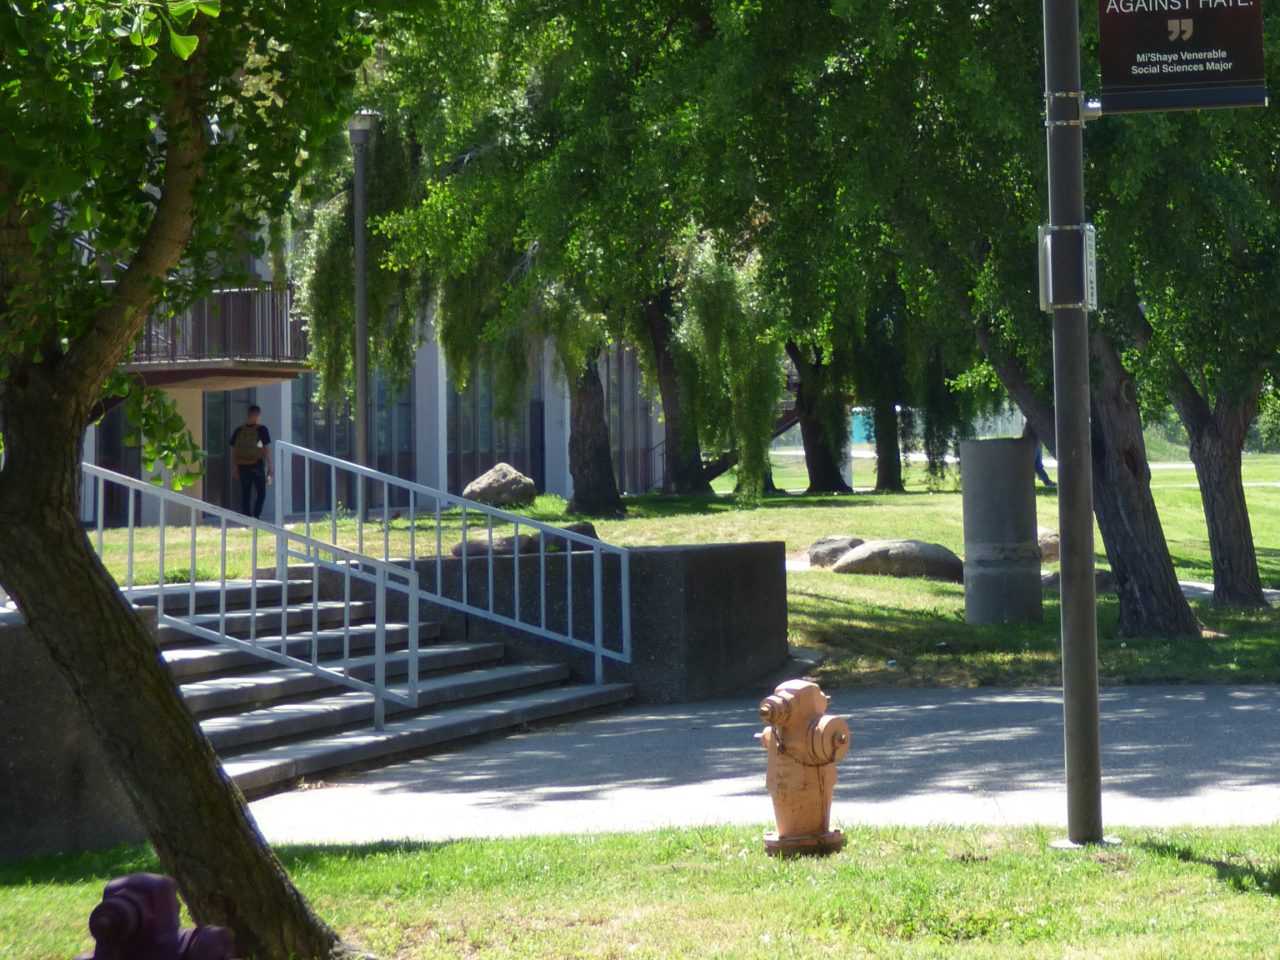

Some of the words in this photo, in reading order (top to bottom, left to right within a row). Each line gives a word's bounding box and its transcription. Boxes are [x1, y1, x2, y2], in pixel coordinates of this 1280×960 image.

[1136, 52, 1179, 62] Mi'Shaye
[1180, 49, 1228, 60] Venerable
[1131, 64, 1160, 75] Social
[1162, 62, 1204, 73] Sciences
[1206, 60, 1233, 72] Major
